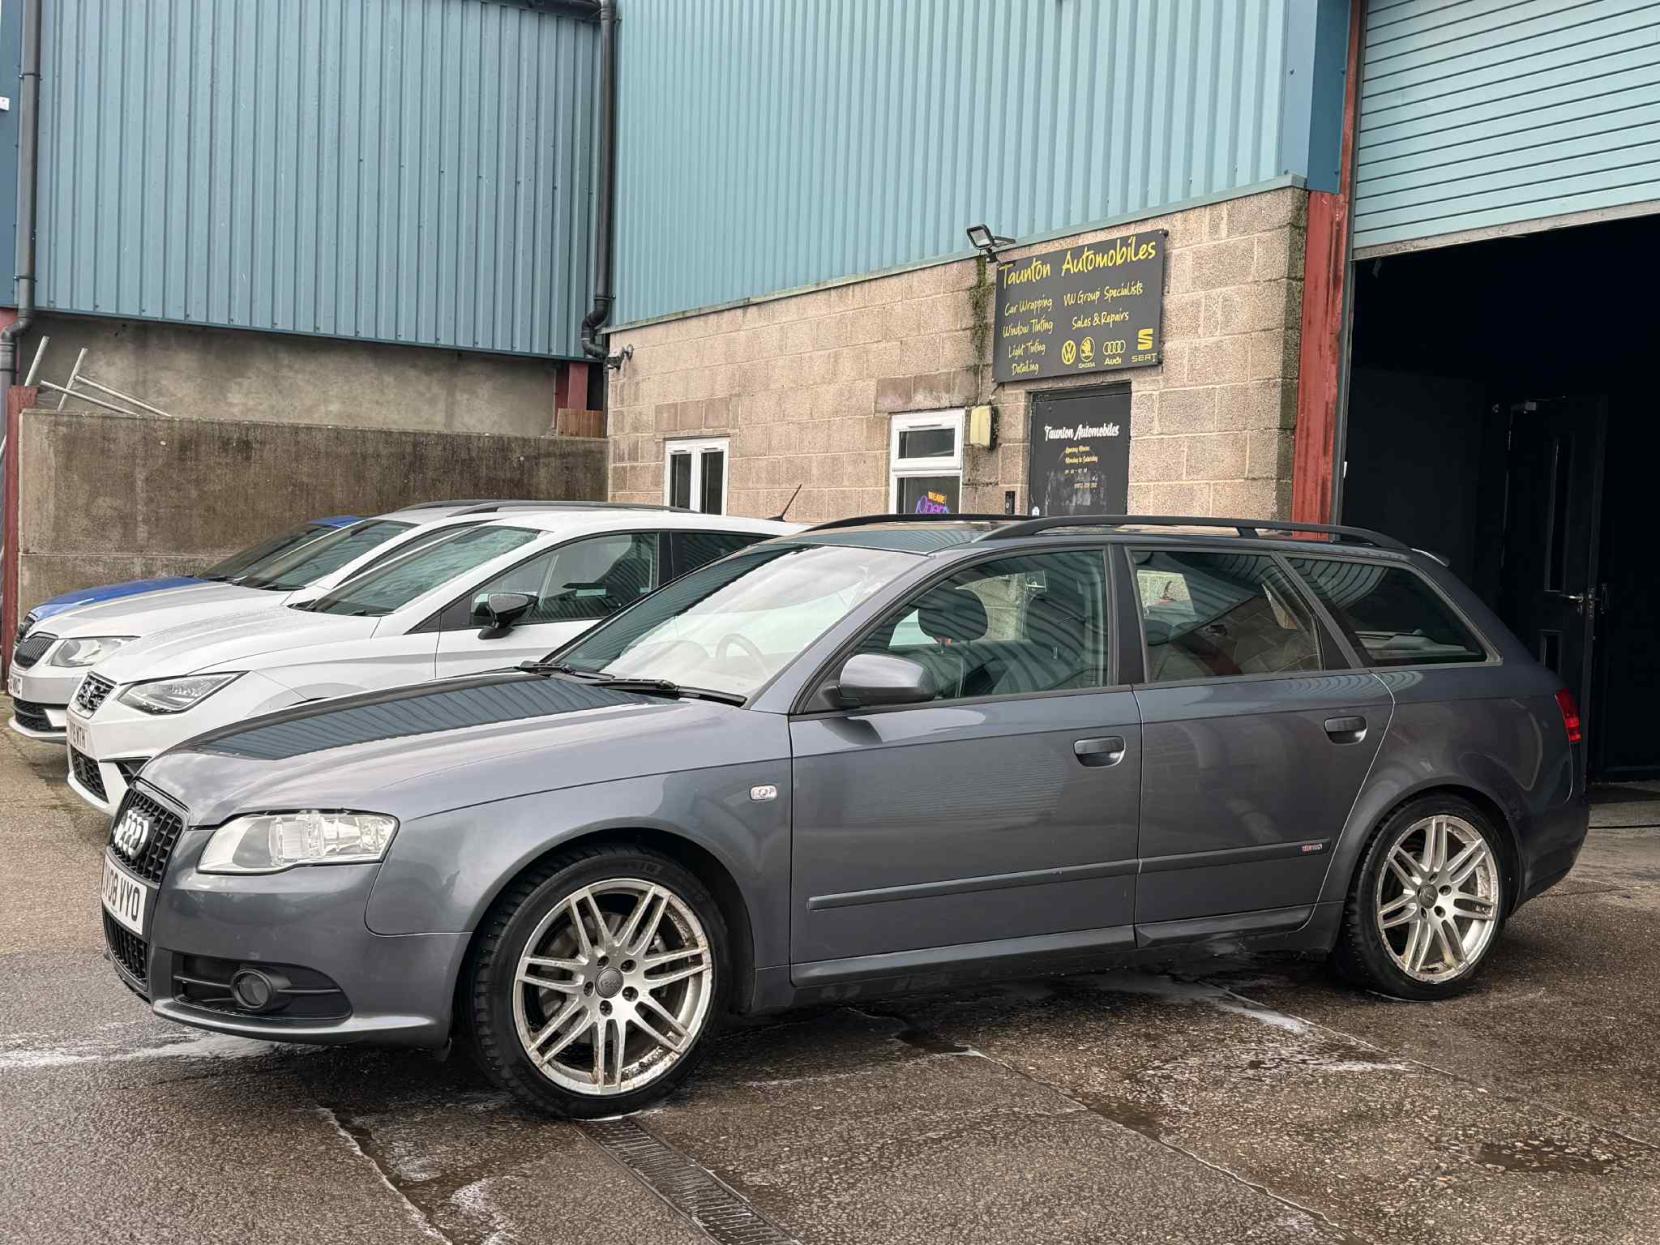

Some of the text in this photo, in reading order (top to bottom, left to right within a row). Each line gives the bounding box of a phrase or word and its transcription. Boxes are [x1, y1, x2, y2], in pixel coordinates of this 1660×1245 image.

[1000, 236, 1156, 290] Taunton Automobiles
[1004, 293, 1053, 316] Car Wrapping
[1077, 288, 1100, 304] Group
[1072, 308, 1129, 330] Sales & Repairs
[1002, 321, 1029, 338] Window
[1131, 353, 1157, 363] SEAT
[1044, 422, 1120, 442] Taunton Automobiles
